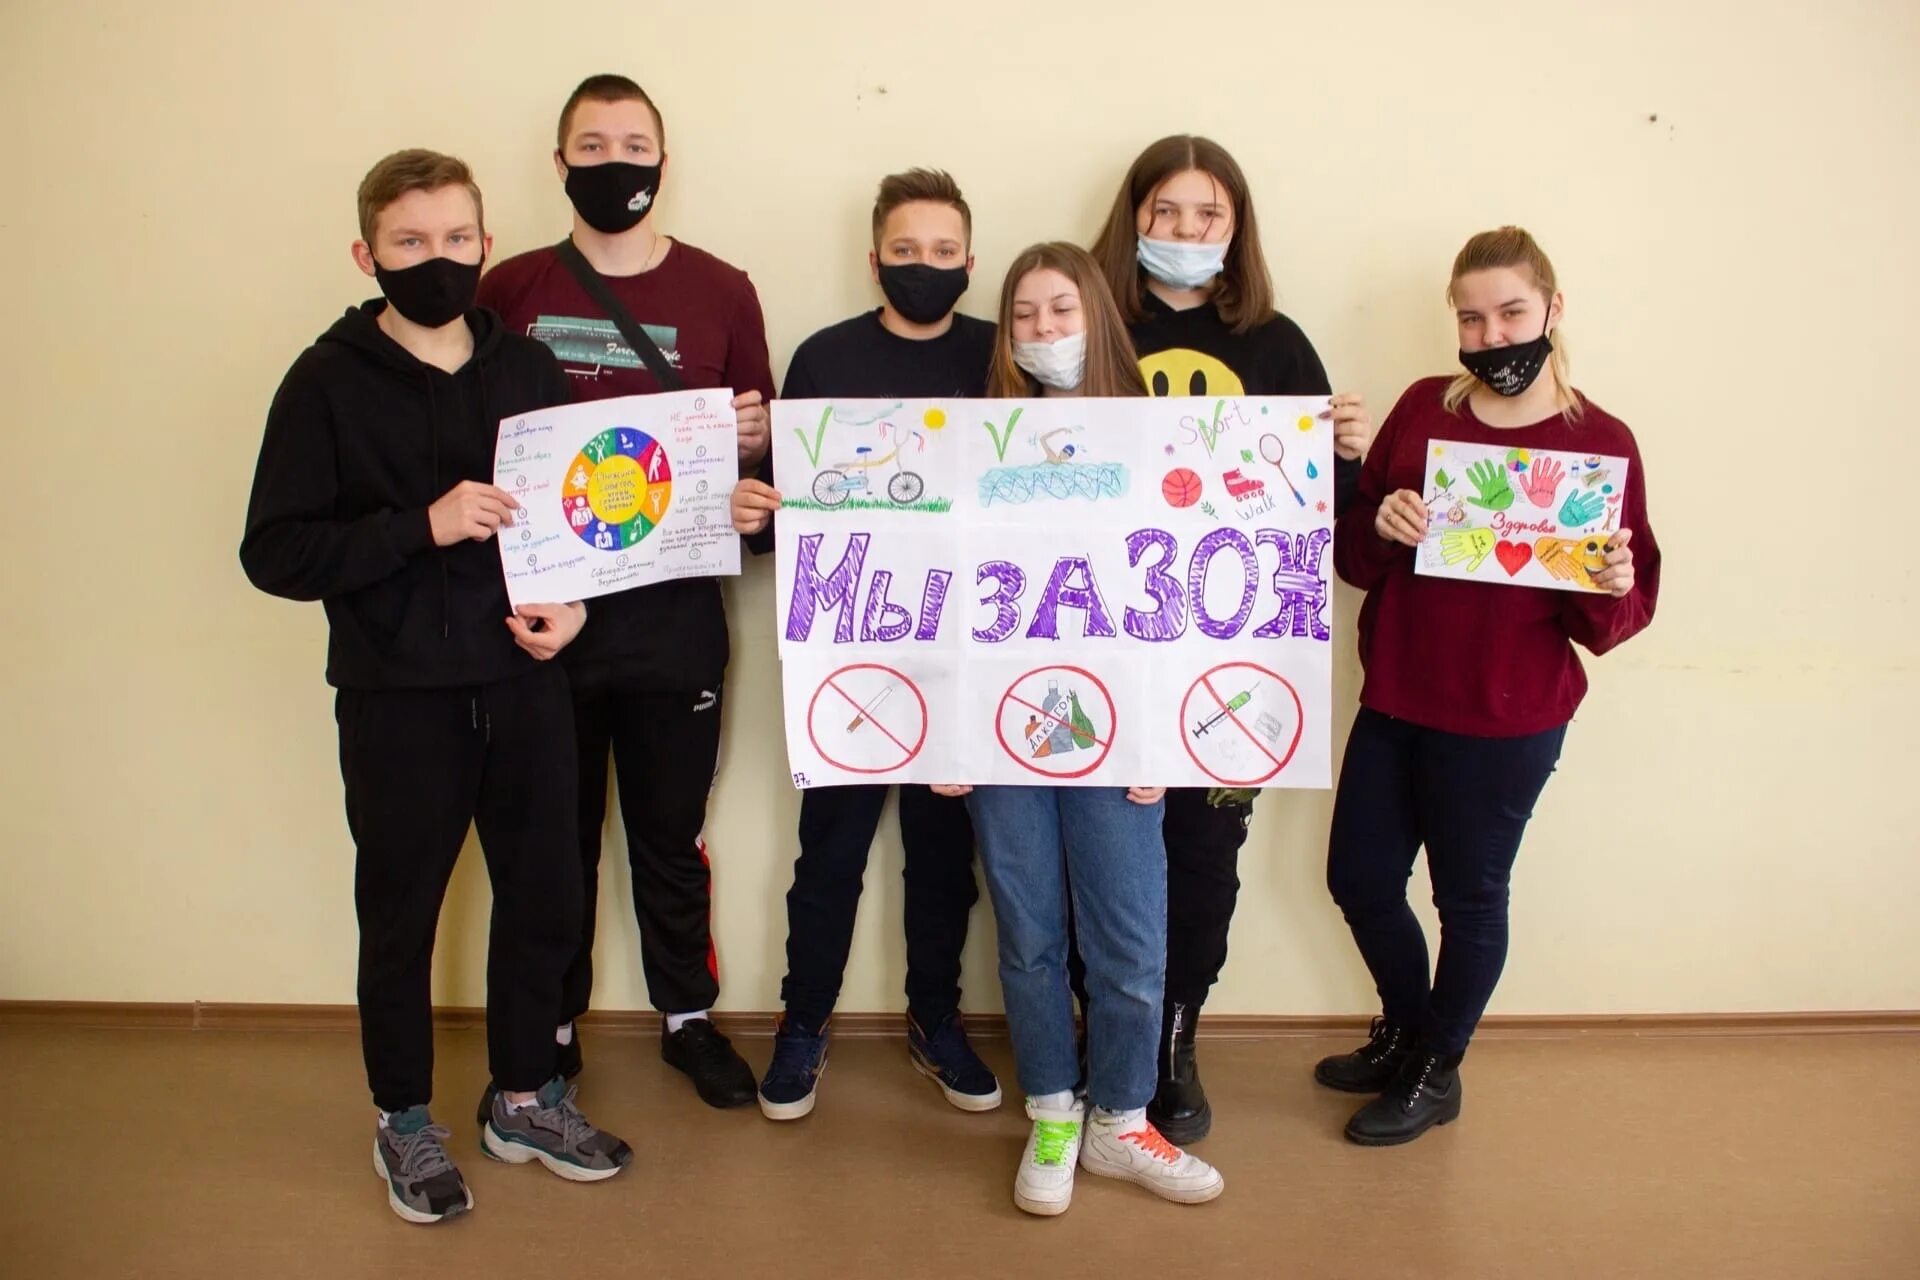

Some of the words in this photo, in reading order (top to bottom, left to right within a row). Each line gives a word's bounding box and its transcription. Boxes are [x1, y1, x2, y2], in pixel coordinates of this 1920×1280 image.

[1179, 400, 1251, 459] Sport
[1235, 494, 1281, 520] Walk
[786, 533, 953, 643] Мы
[1123, 527, 1331, 642] ЗОЖ
